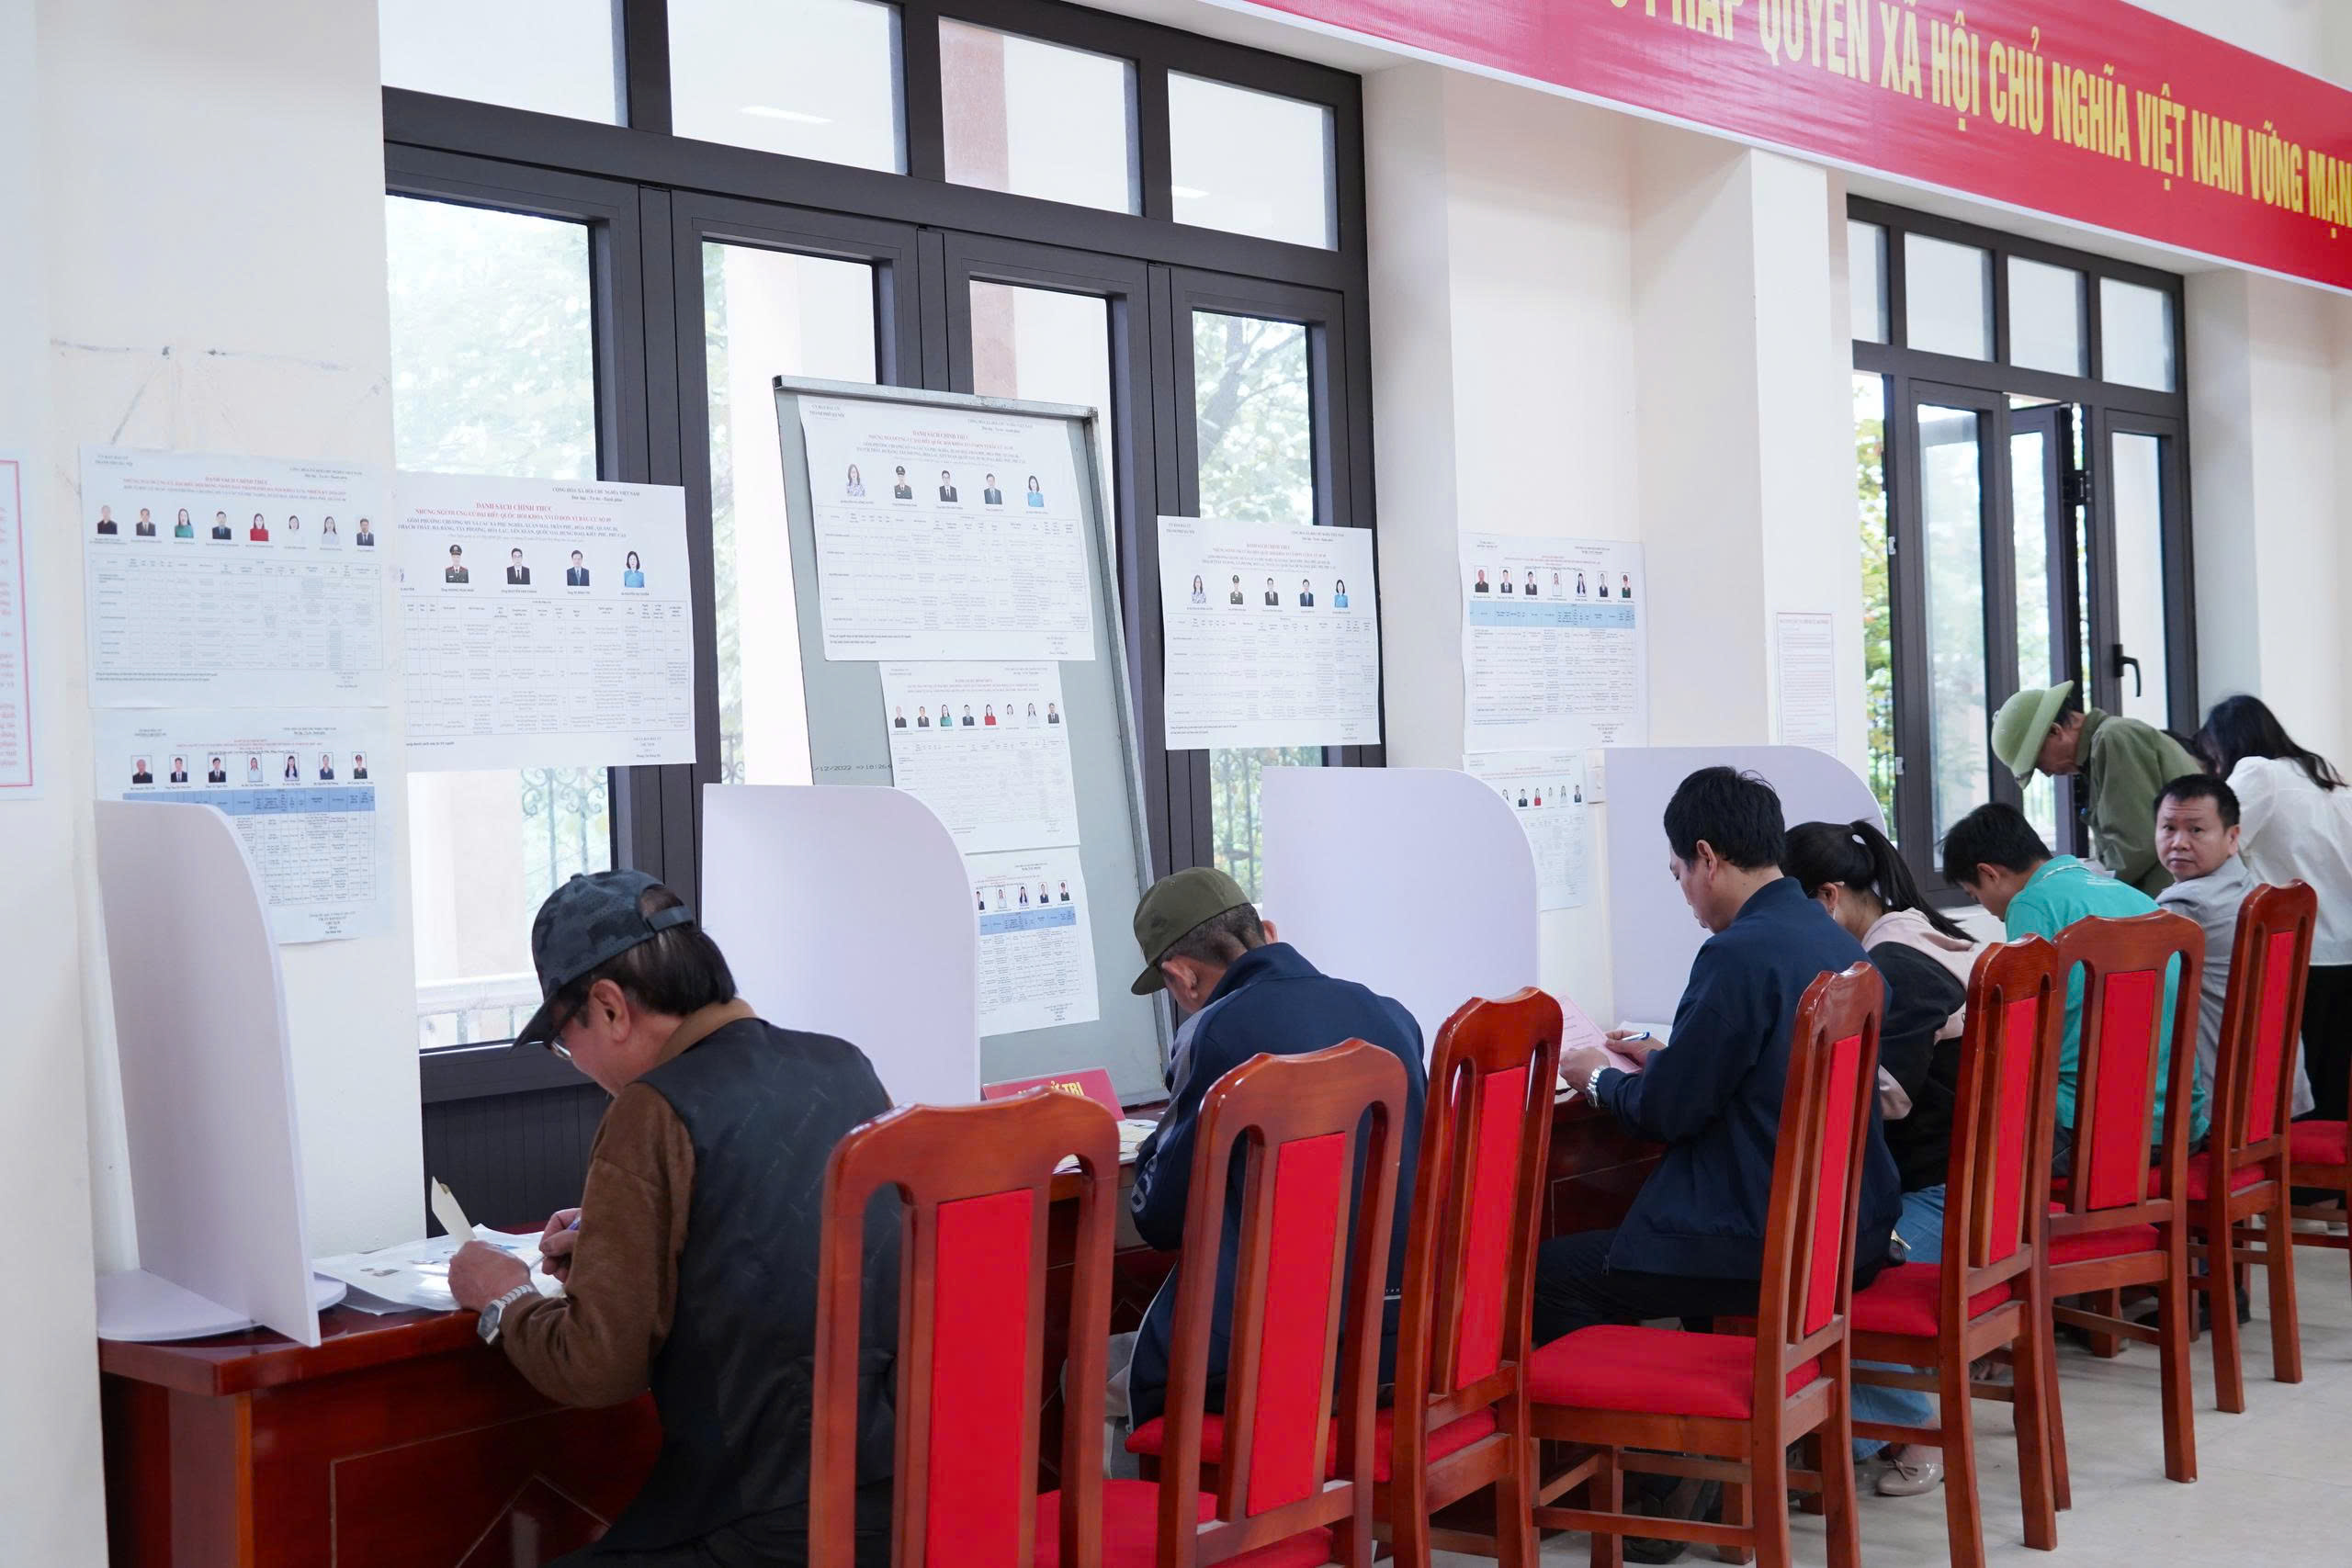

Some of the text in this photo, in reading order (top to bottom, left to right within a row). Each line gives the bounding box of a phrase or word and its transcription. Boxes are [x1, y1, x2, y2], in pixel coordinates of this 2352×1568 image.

[1880, 0, 1923, 99] XÃ
[1931, 9, 1980, 131] HỘI
[1989, 26, 2043, 135] CHỦ
[2052, 62, 2131, 162] NGHĨA
[2136, 83, 2186, 191] VIỆT
[2192, 109, 2244, 195] NAM
[2248, 120, 2303, 213] VỮNG
